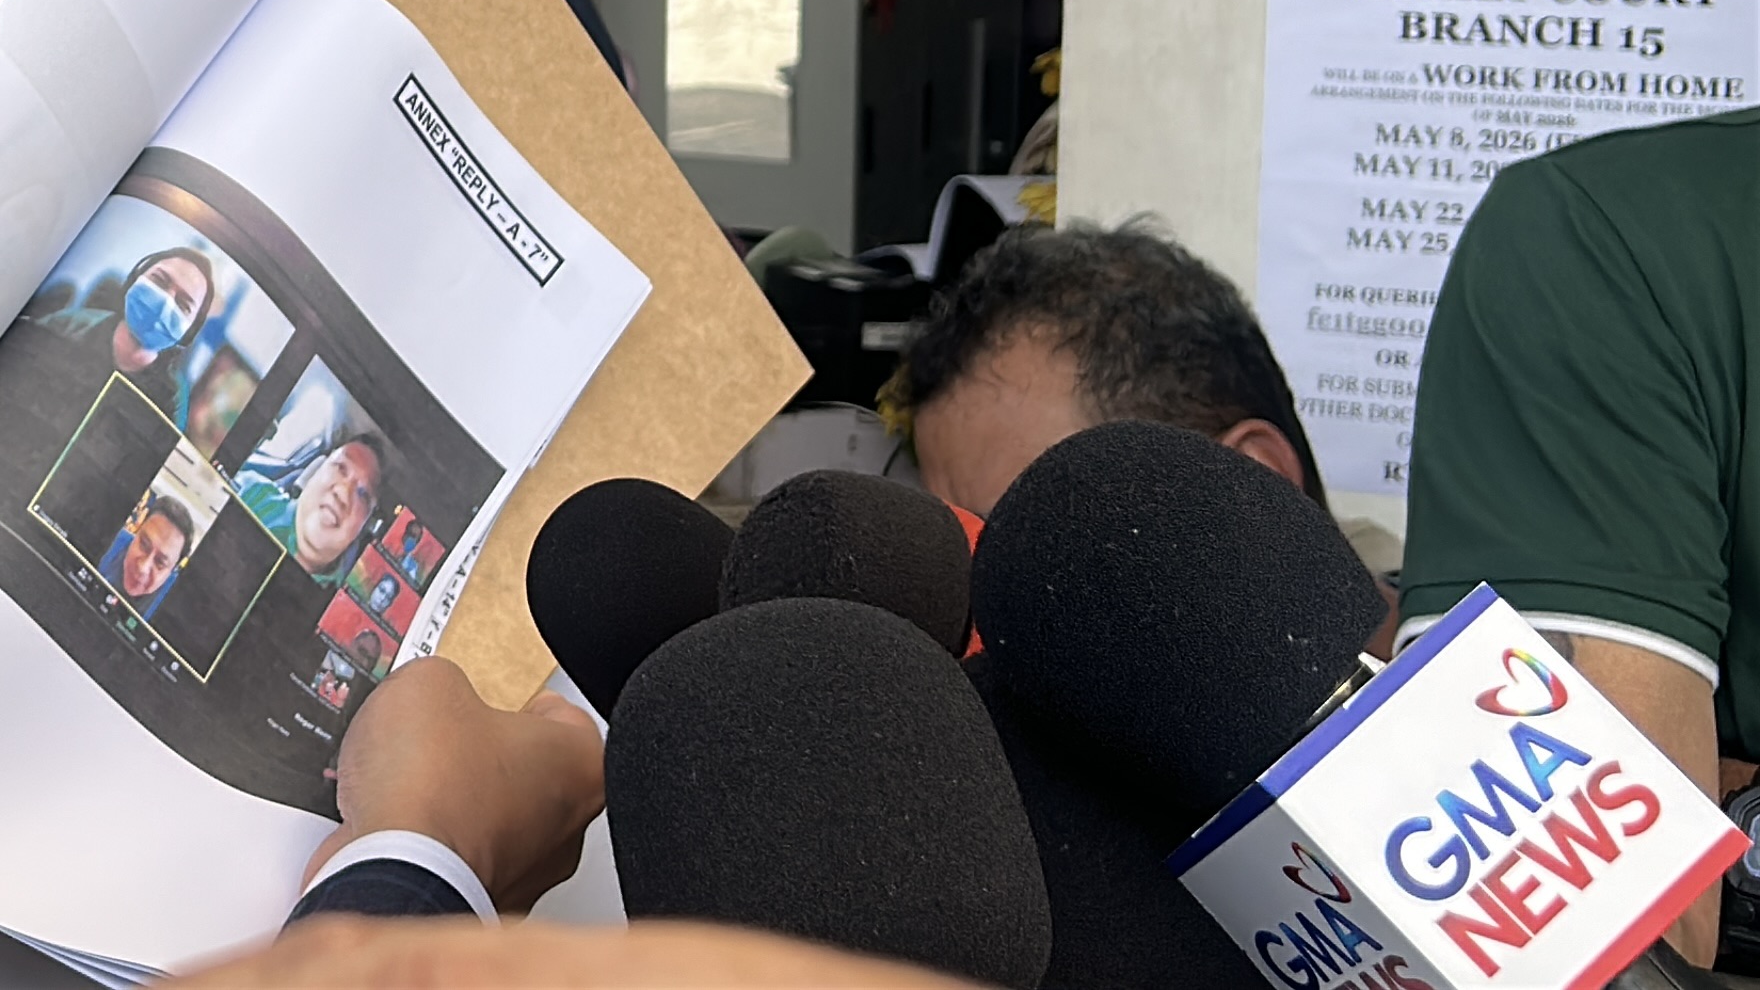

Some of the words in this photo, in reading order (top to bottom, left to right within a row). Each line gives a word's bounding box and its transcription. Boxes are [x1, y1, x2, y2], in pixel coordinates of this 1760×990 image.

[1399, 11, 1604, 49] BRANCH
[1619, 25, 1665, 59] 15
[1423, 63, 1525, 89] WORK
[1534, 68, 1628, 93] FROM
[1640, 73, 1744, 99] HOME
[1376, 122, 1442, 148] MAY
[1451, 127, 1472, 150] 8,
[1478, 129, 1537, 151] 2026
[405, 93, 451, 153] ANNEX
[506, 222, 524, 241] A
[1354, 152, 1421, 178] MAY
[1428, 158, 1465, 183] 11,
[1471, 160, 1500, 180] 20
[1361, 197, 1429, 222] MAY
[1346, 227, 1414, 252] MAY
[1315, 283, 1356, 304] FOR
[1376, 349, 1410, 368] OR
[1317, 374, 1359, 393] FOR
[1367, 403, 1413, 422] DOC
[1384, 721, 1594, 902] GMA
[1434, 759, 1662, 969] NEWS
[1254, 897, 1385, 990] GMA
